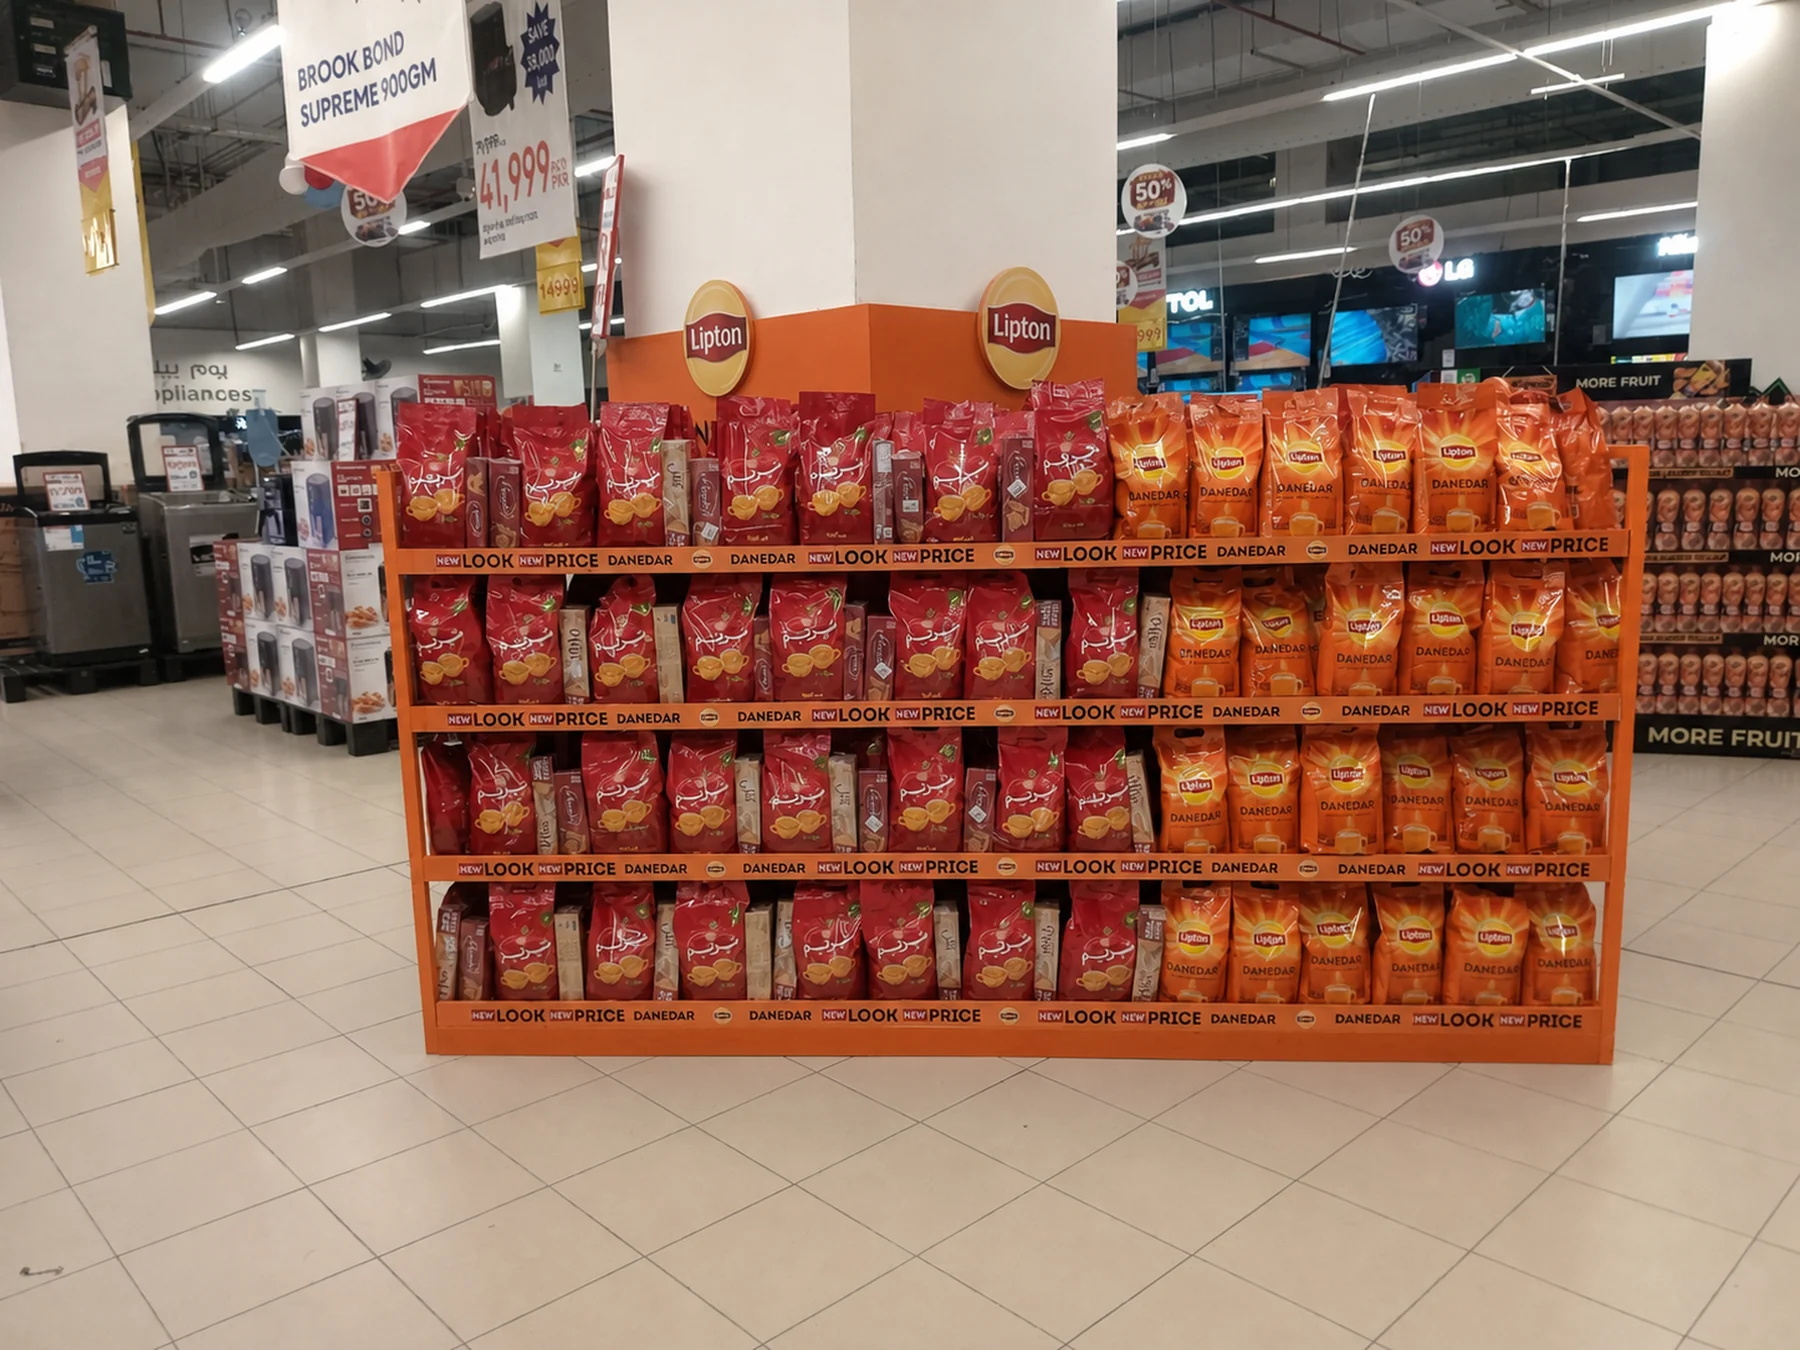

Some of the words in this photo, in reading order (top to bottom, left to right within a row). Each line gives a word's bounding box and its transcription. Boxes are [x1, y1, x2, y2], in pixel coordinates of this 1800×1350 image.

[297, 51, 360, 91] BROOK
[364, 31, 405, 71] BOND
[300, 84, 380, 128] SUPREME
[381, 58, 437, 102] 900GM
[480, 140, 549, 213] 41,999
[1444, 258, 1473, 281] LG
[994, 313, 1050, 344] Lipton
[691, 325, 742, 354] Lipton
[1576, 377, 1617, 388] MORE
[1621, 375, 1661, 387] FRUIT
[1443, 447, 1473, 457] Lipton
[1432, 479, 1488, 489] DANEDAR
[1036, 548, 1060, 560] NEW
[1064, 546, 1116, 561] LOOK
[1124, 548, 1147, 558] NEW
[1151, 545, 1206, 560] PRICE
[1218, 545, 1285, 557] DANEDAR
[1349, 543, 1417, 555] DANEDAR
[1431, 542, 1457, 554] NEW
[1460, 539, 1515, 555] LOOK
[1522, 541, 1548, 552] NEW
[1551, 537, 1608, 552] PRICE
[437, 556, 459, 566] NEW
[463, 554, 513, 568] LOOK
[519, 556, 543, 566] NEW
[546, 554, 598, 567] PRICE
[609, 555, 672, 565] DANEDAR
[731, 554, 795, 564] DANEDAR
[809, 552, 832, 564] NEW
[836, 550, 887, 564] LOOK
[894, 552, 916, 562] NEW
[921, 549, 973, 563] PRICE
[1337, 654, 1392, 664] DANEDAR
[738, 711, 800, 721] DANEDAR
[812, 710, 836, 721] NEW
[839, 708, 889, 721] LOOK
[896, 710, 919, 720] NEW
[923, 707, 974, 720] PRICE
[1036, 708, 1060, 718] NEW
[1063, 705, 1115, 720] LOOK
[1121, 707, 1144, 718] NEW
[1148, 705, 1202, 719] PRICE
[1213, 707, 1279, 717] DANEDAR
[1343, 705, 1409, 716] DANEDAR
[1424, 704, 1449, 716] NEW
[1453, 702, 1507, 717] LOOK
[1513, 703, 1539, 715] NEW
[1542, 701, 1598, 715] PRICE
[449, 715, 472, 724] NEW
[474, 713, 524, 726] LOOK
[530, 714, 553, 724] NEW
[556, 712, 607, 725] PRICE
[618, 713, 680, 724] DANEDAR
[1648, 726, 1723, 745] MORE
[1731, 729, 1800, 749] FRUIT
[1240, 806, 1292, 816] DANEDAR
[1320, 800, 1374, 811] DANEDAR
[1170, 811, 1221, 822] DANEDAR
[460, 864, 482, 874] NEW
[485, 863, 533, 876] LOOK
[538, 864, 562, 874] NEW
[565, 863, 615, 875] PRICE
[625, 864, 686, 873] DANEDAR
[744, 863, 805, 873] DANEDAR
[818, 862, 841, 873] NEW
[844, 861, 894, 874] LOOK
[900, 862, 923, 872] NEW
[926, 860, 978, 873] PRICE
[1036, 862, 1060, 872] NEW
[1064, 860, 1115, 873] LOOK
[1122, 862, 1145, 872] NEW
[1148, 860, 1202, 874] PRICE
[1212, 863, 1277, 873] DANEDAR
[1339, 864, 1405, 874] DANEDAR
[1419, 864, 1444, 875] NEW
[1447, 863, 1500, 877] LOOK
[1506, 863, 1532, 875] NEW
[1535, 863, 1589, 877] PRICE
[472, 1010, 494, 1020] NEW
[497, 1009, 544, 1022] LOOK
[550, 1010, 573, 1020] NEW
[575, 1009, 624, 1022] PRICE
[634, 1011, 694, 1020] DANEDAR
[750, 1011, 811, 1020] DANEDAR
[823, 1010, 846, 1020] NEW
[849, 1009, 897, 1022] LOOK
[904, 1010, 926, 1020] NEW
[930, 1009, 980, 1022] PRICE
[1038, 1011, 1062, 1022] NEW
[1066, 1010, 1115, 1024] LOOK
[1122, 1012, 1145, 1022] NEW
[1149, 1012, 1200, 1025] PRICE
[1211, 1014, 1275, 1024] DANEDAR
[1336, 1014, 1400, 1024] DANEDAR
[1414, 1014, 1438, 1025] NEW
[1441, 1013, 1494, 1027] LOOK
[1500, 1015, 1525, 1026] NEW
[1528, 1014, 1581, 1028] PRICE
